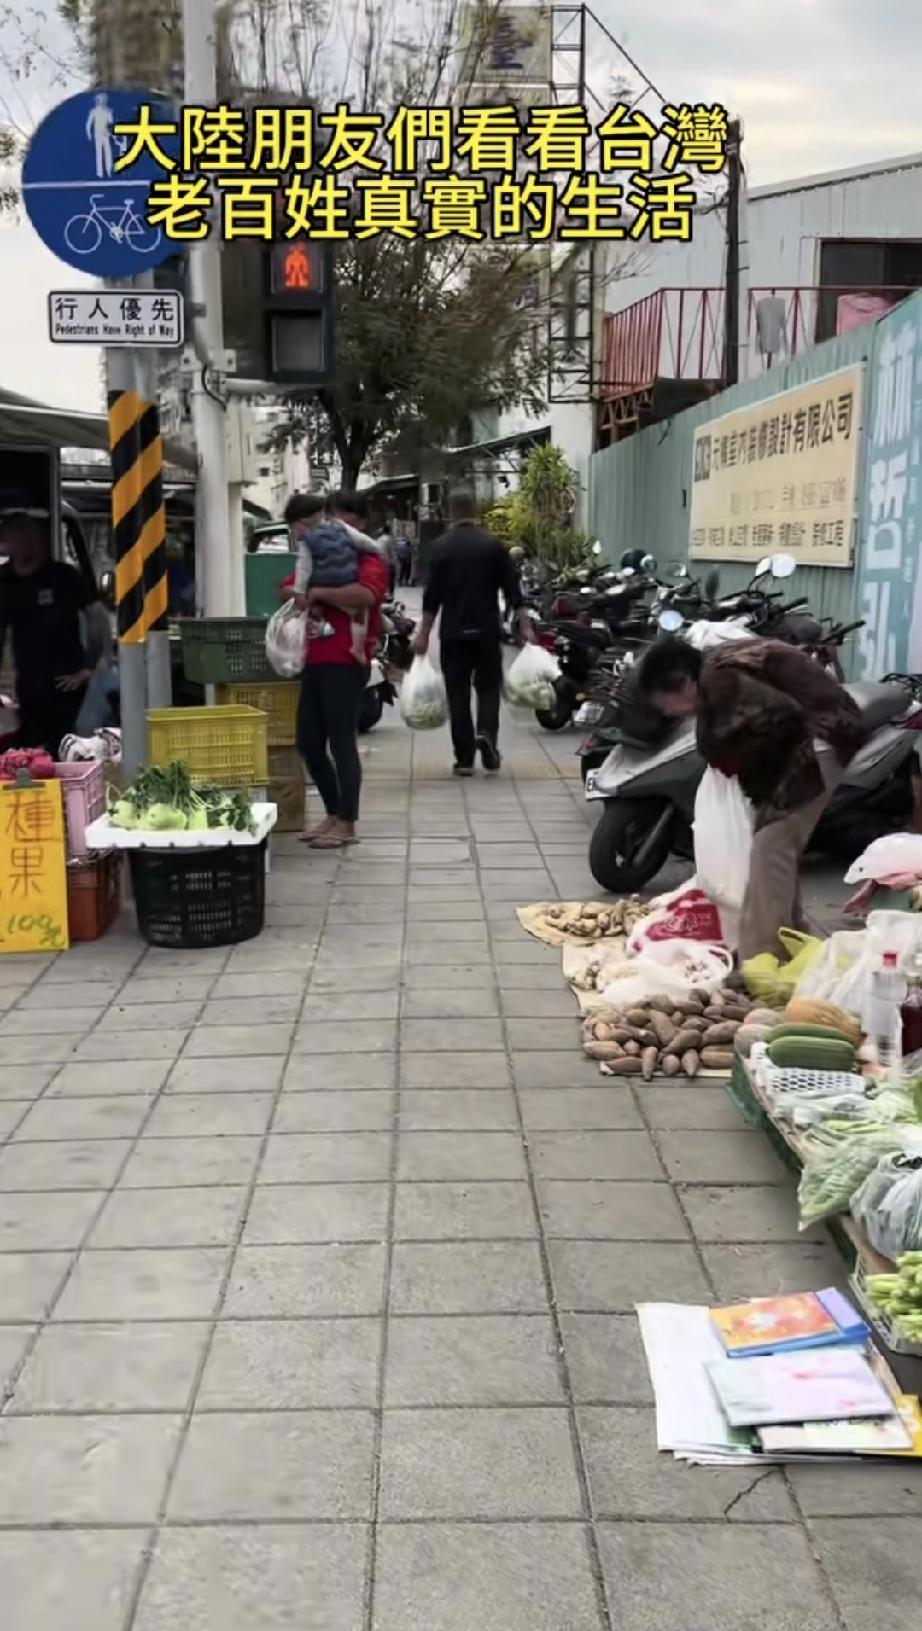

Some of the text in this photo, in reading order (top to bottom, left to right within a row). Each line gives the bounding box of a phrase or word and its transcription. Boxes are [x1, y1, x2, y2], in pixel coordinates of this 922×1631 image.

[54, 297, 175, 321] 行人優先
[55, 323, 174, 338] Pedestrians Have Right of Way
